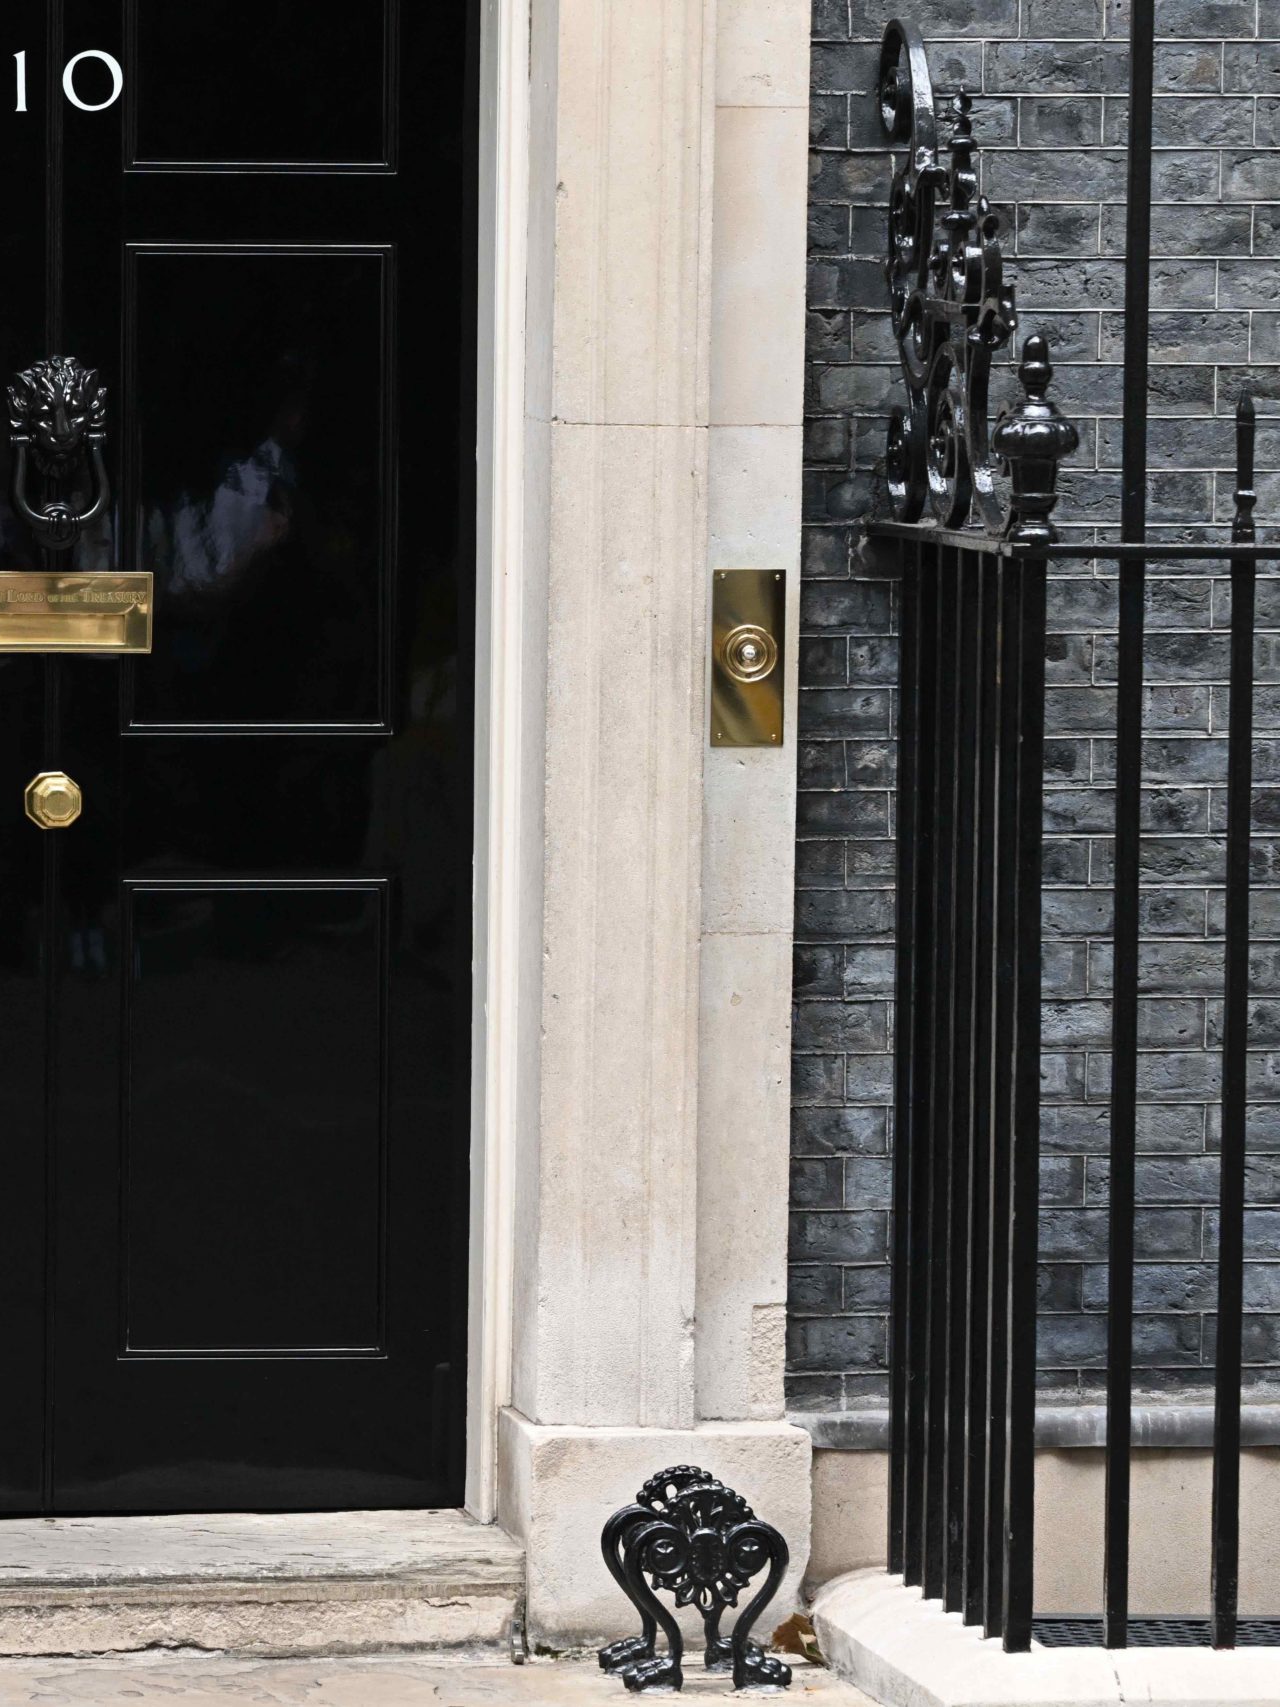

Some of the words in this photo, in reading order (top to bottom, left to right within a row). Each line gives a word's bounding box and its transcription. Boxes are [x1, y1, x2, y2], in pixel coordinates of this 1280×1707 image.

[12, 49, 123, 112] 10
[6, 588, 44, 603] LORD
[82, 590, 146, 604] TREASURY
